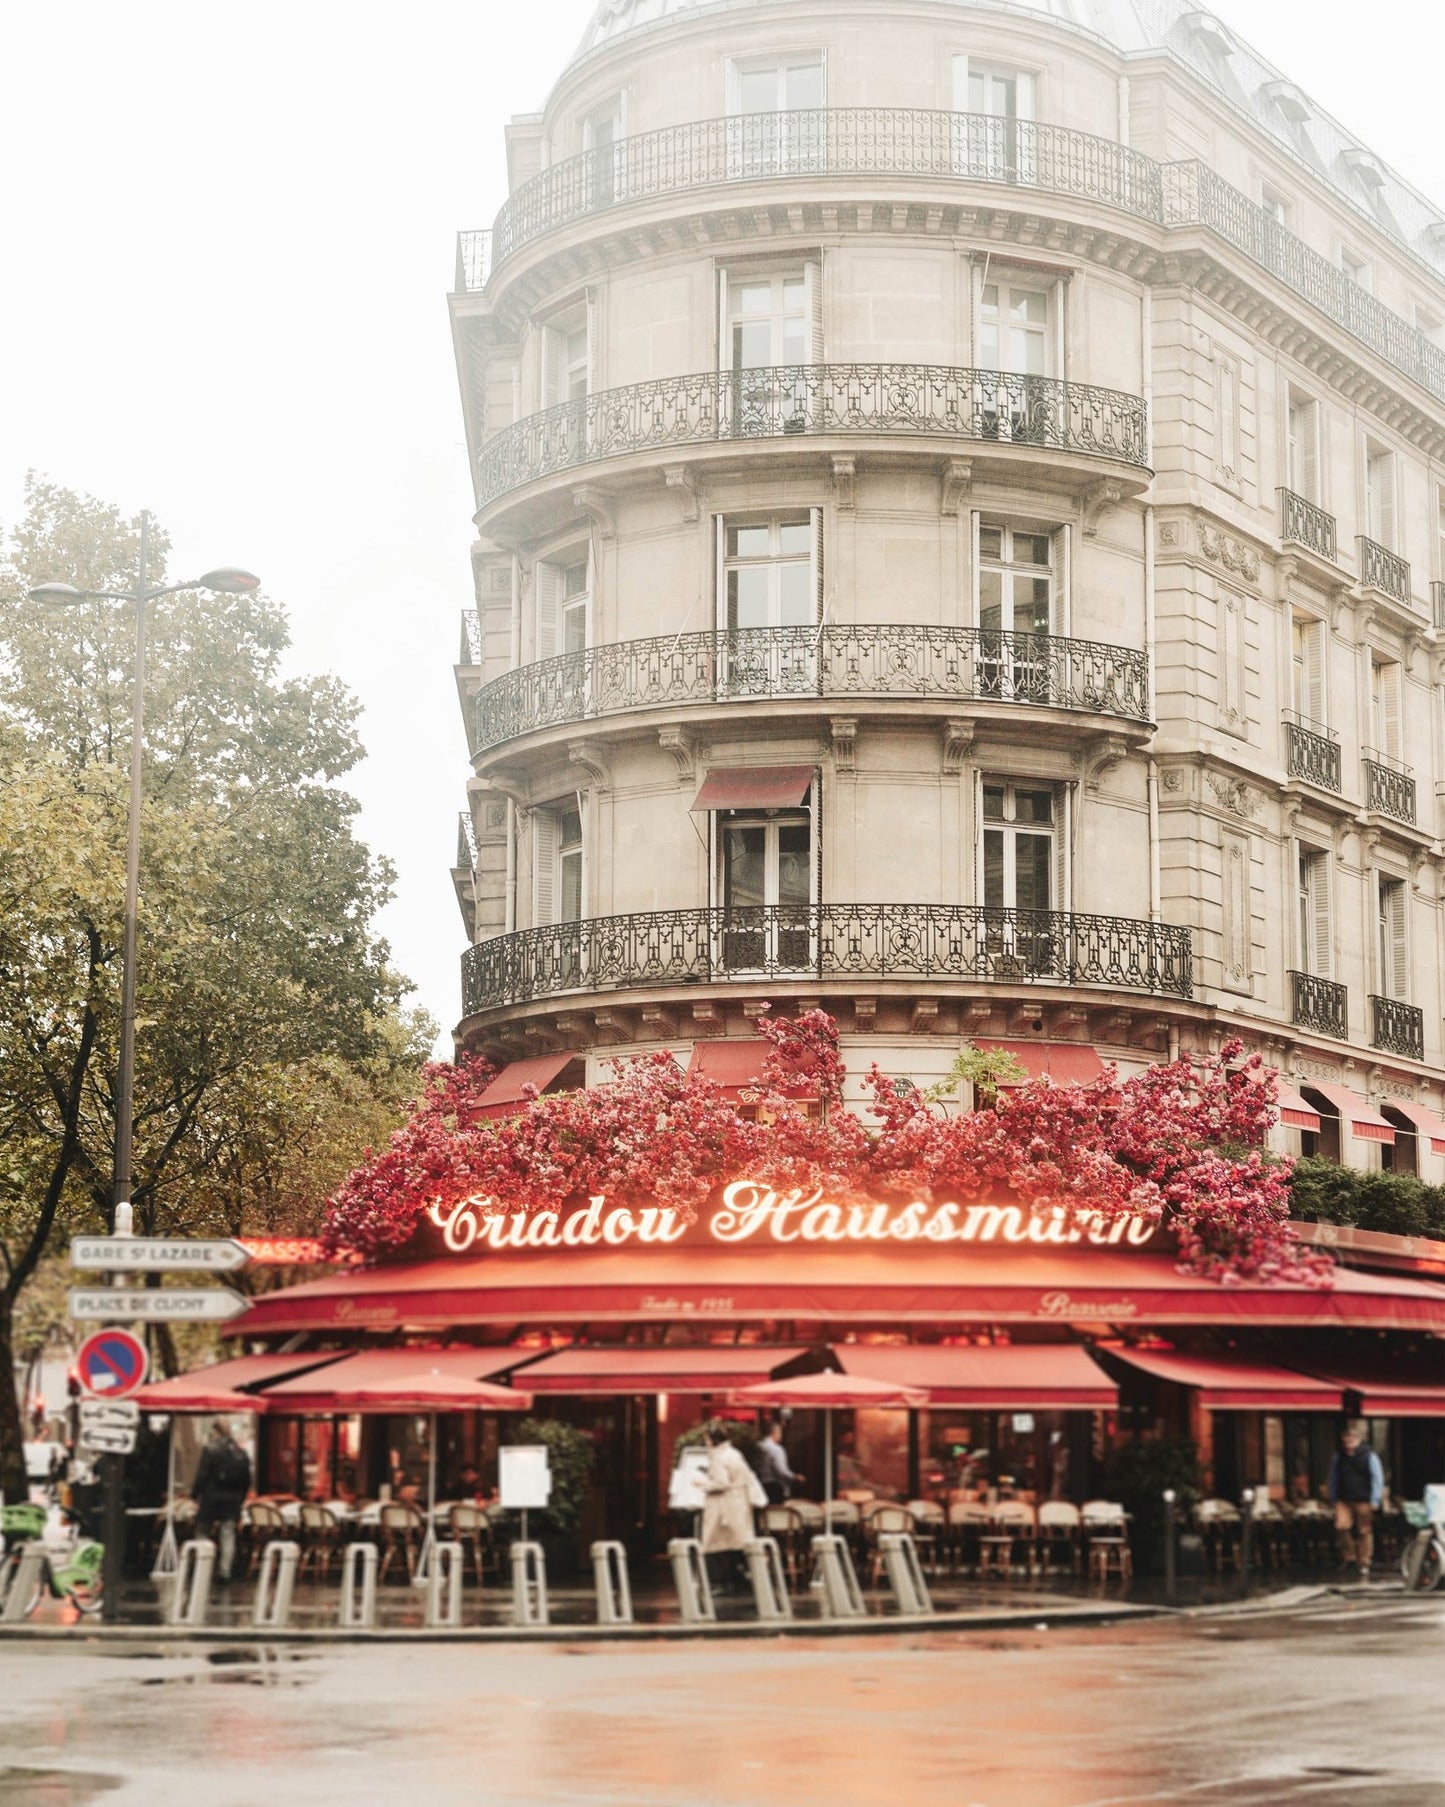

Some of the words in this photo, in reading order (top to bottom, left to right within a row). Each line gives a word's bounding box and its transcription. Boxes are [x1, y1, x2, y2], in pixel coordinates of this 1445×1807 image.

[80, 1246, 125, 1260] GARE
[150, 1247, 213, 1261] LAZARE
[77, 1297, 125, 1311] PLACE
[130, 1297, 150, 1311] DE
[153, 1297, 206, 1311] CLICHY
